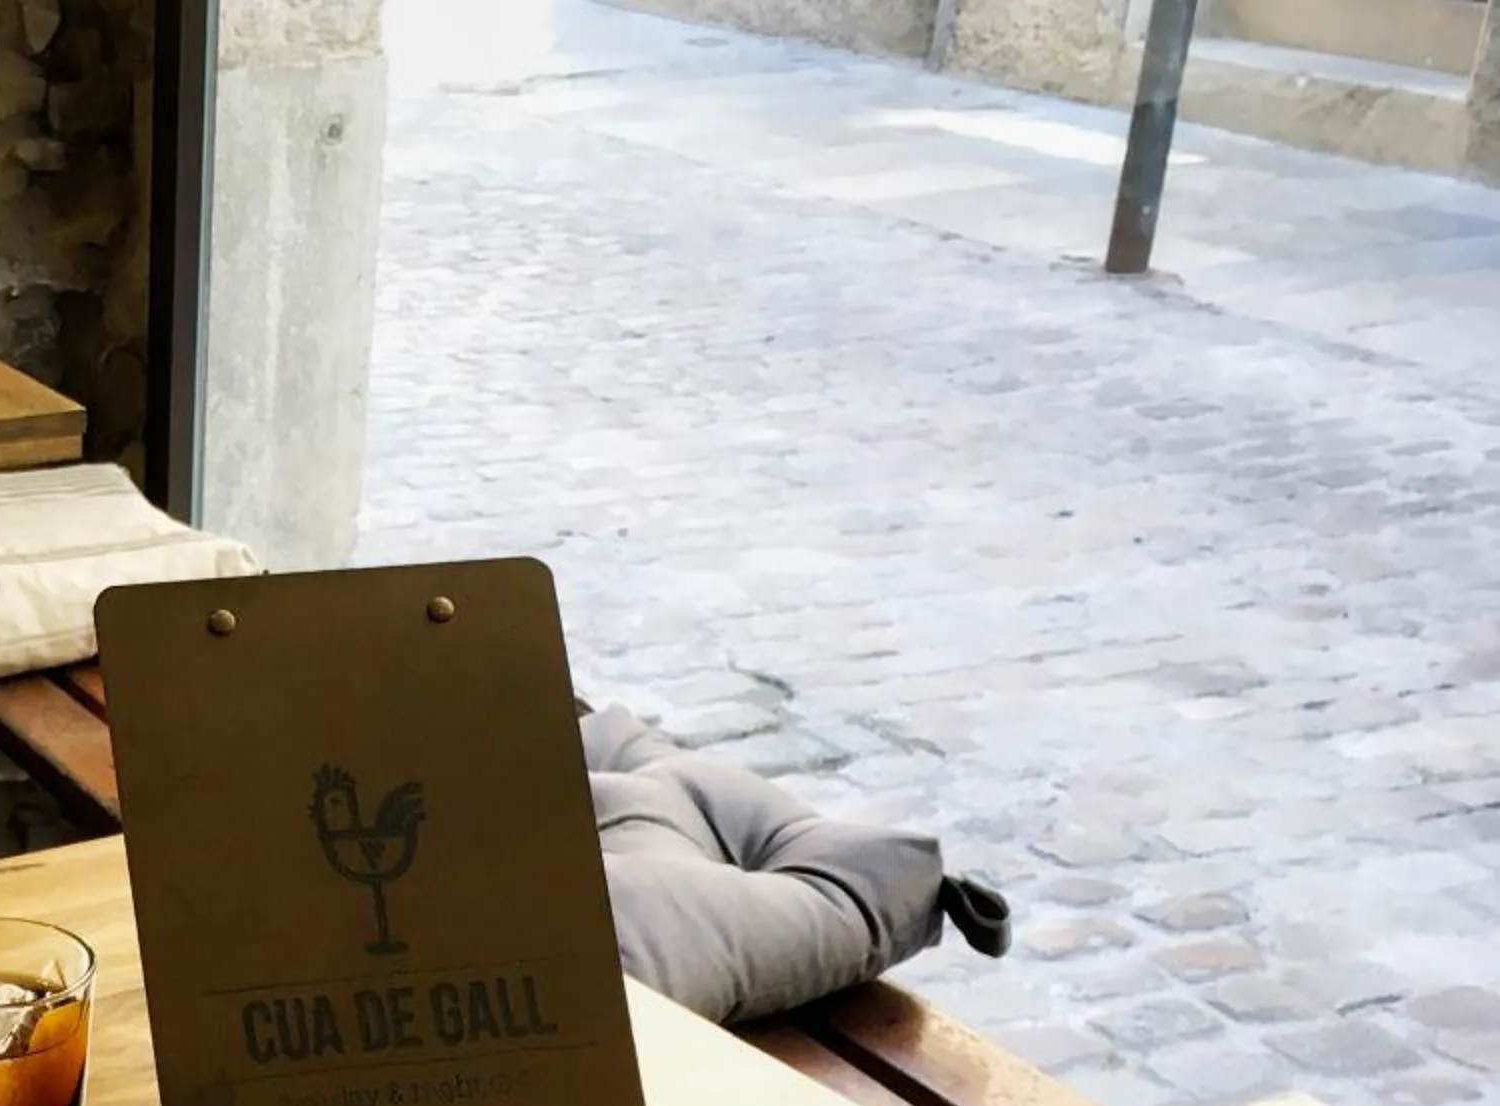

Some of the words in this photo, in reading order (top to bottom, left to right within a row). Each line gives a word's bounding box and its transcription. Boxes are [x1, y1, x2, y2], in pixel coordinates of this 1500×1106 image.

[242, 994, 345, 1064] CUA
[354, 985, 424, 1053] DE
[430, 974, 559, 1046] GALL
